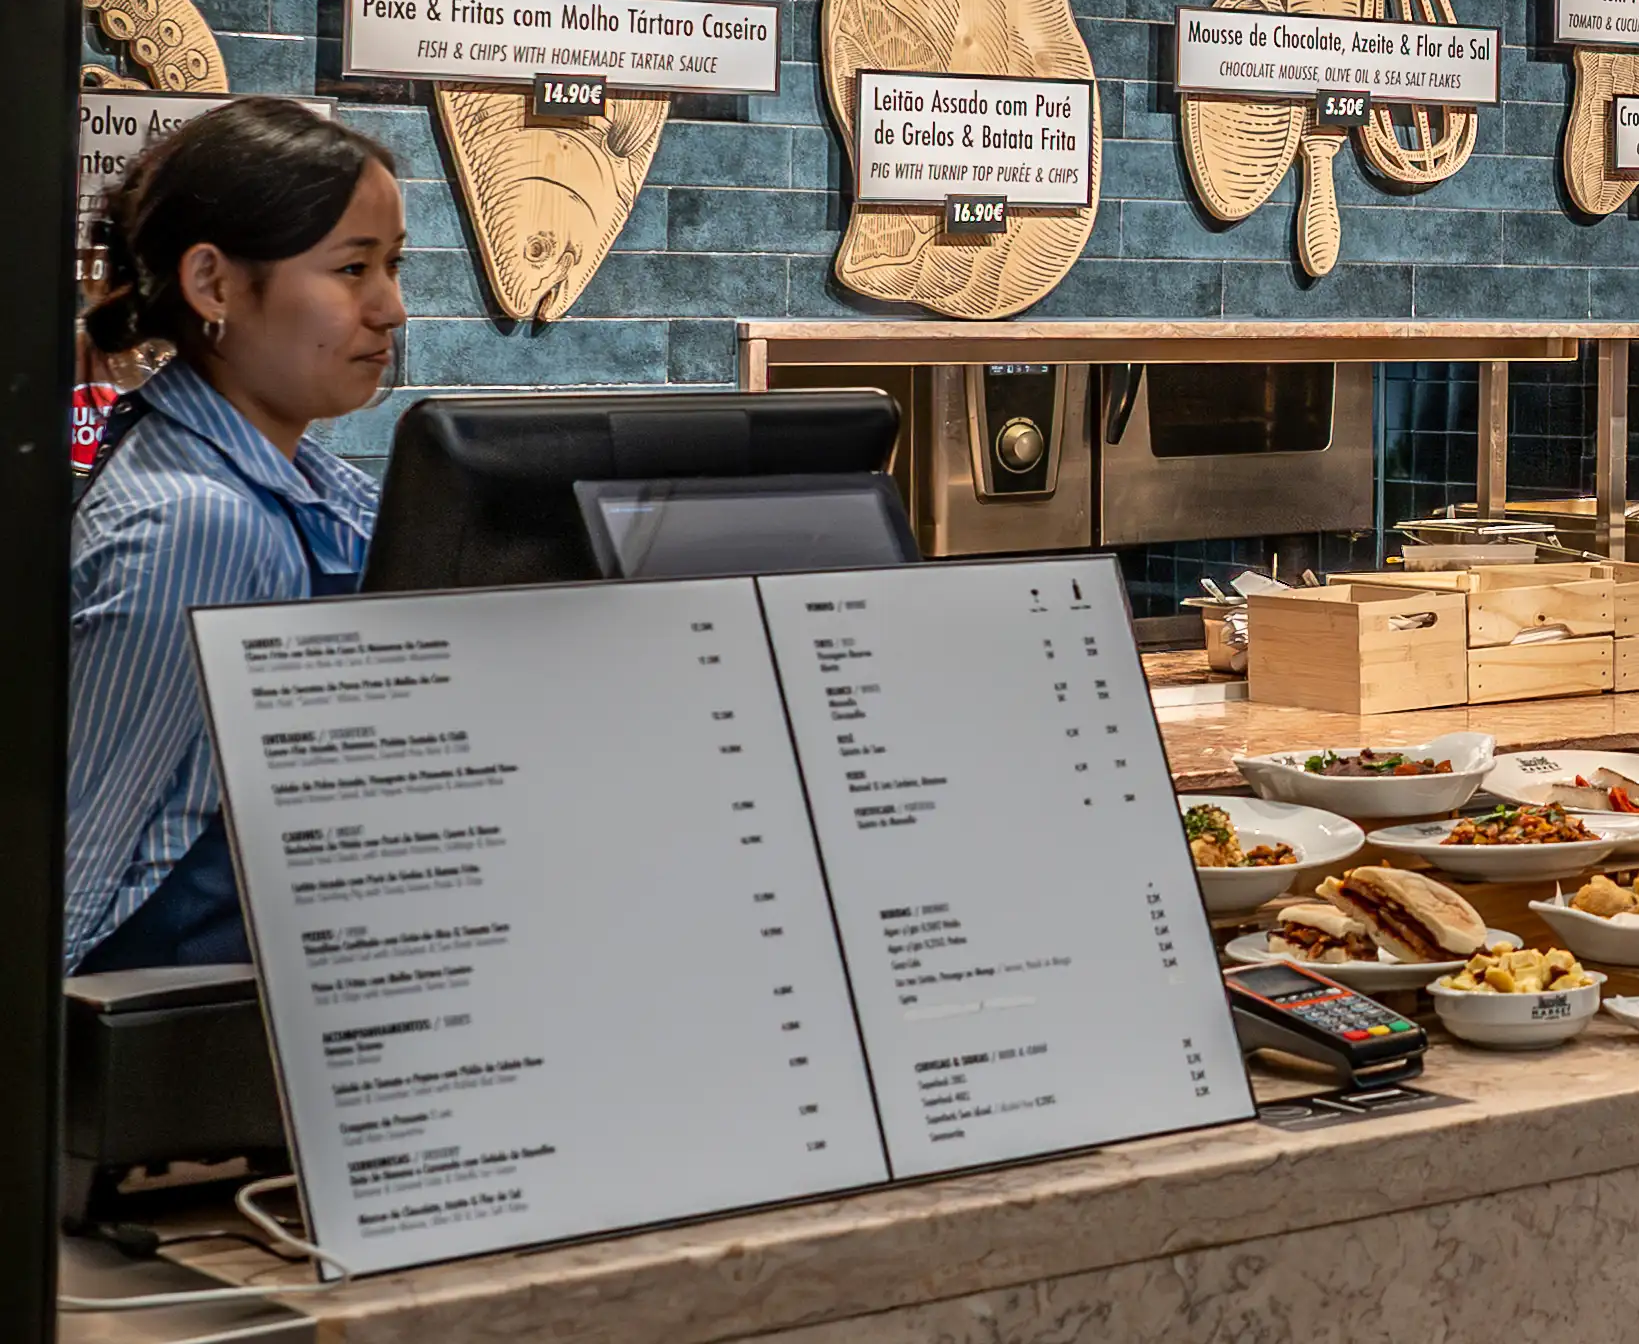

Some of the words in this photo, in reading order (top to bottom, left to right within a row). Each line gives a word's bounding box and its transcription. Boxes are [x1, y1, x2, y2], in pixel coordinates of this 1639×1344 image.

[544, 82, 602, 105] 14.90€
[1325, 96, 1364, 116] 5.50€
[954, 203, 1004, 222] 16.90€
